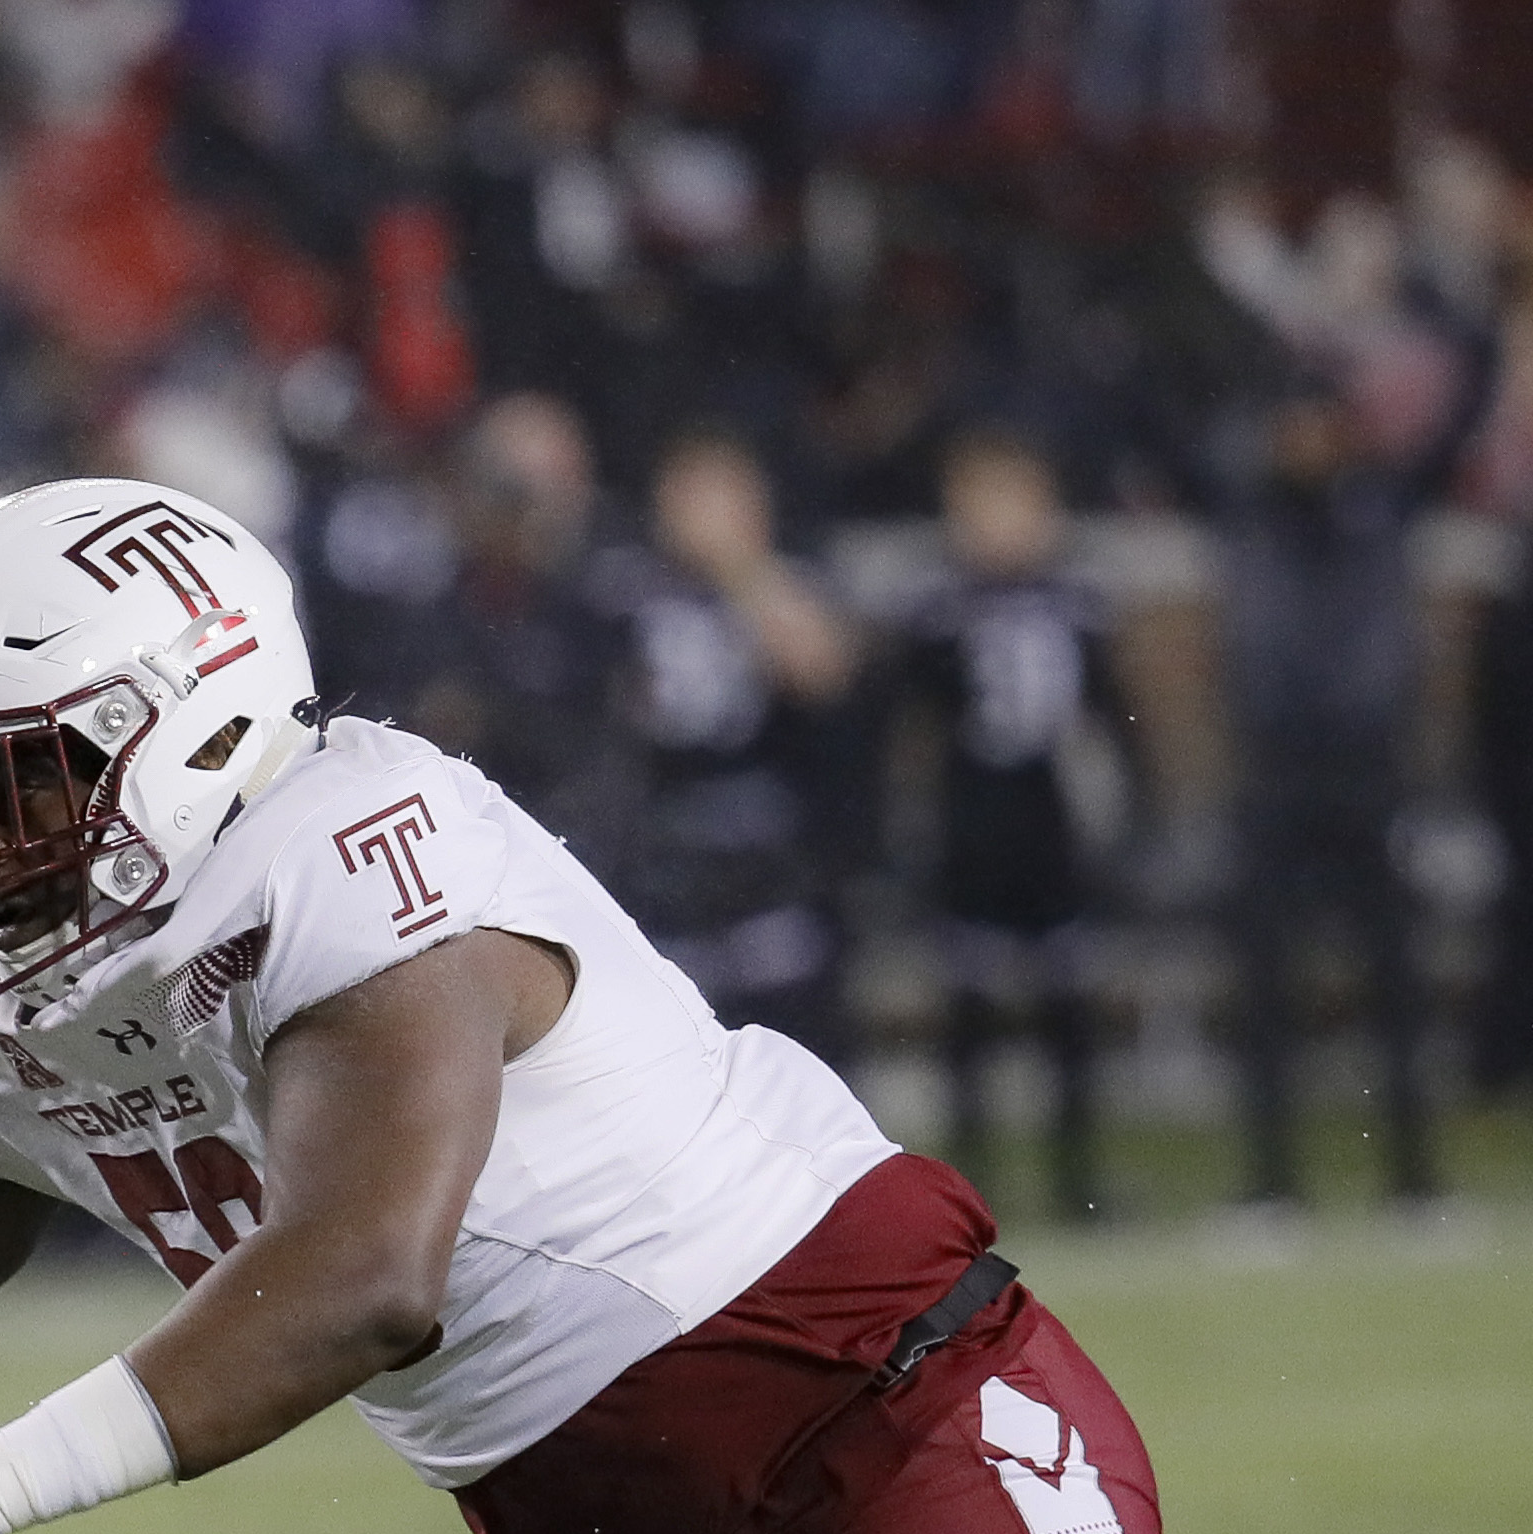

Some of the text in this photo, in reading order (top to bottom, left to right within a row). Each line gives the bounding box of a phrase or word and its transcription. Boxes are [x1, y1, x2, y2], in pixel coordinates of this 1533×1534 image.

[63, 501, 259, 677] T
[332, 792, 448, 939] T
[37, 1073, 208, 1140] TEMPLE
